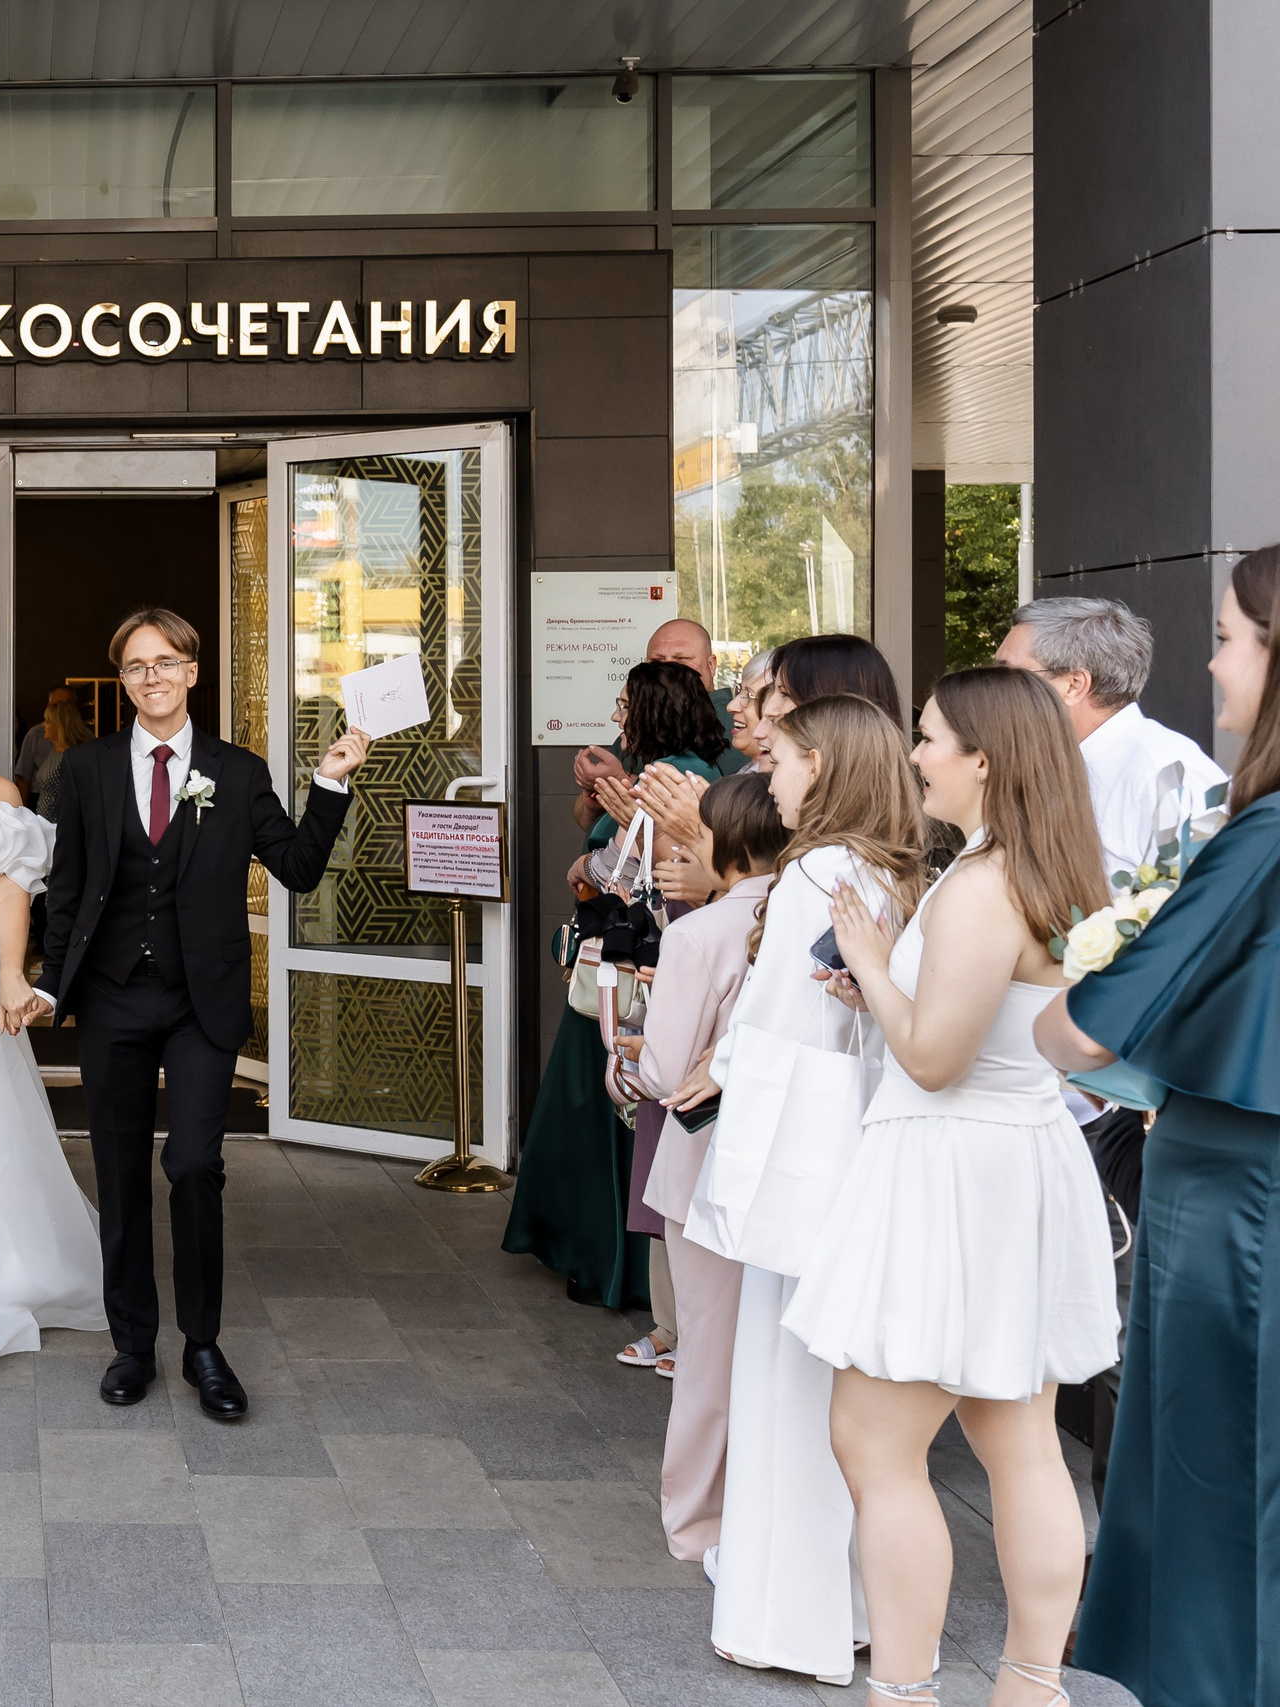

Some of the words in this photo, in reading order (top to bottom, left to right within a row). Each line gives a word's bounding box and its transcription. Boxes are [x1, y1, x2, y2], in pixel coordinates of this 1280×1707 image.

[546, 643, 580, 651] РЕЖИМ
[582, 643, 618, 651] РАБОТЫ
[610, 657, 631, 666] 9:00
[607, 673, 629, 682] 10:00
[418, 811, 452, 819] Уважаемые
[453, 823, 479, 831] Дворца!
[412, 831, 464, 841] УБЕДИТЕЛЬНАЯ
[466, 833, 499, 843] ПРОСЬБА
